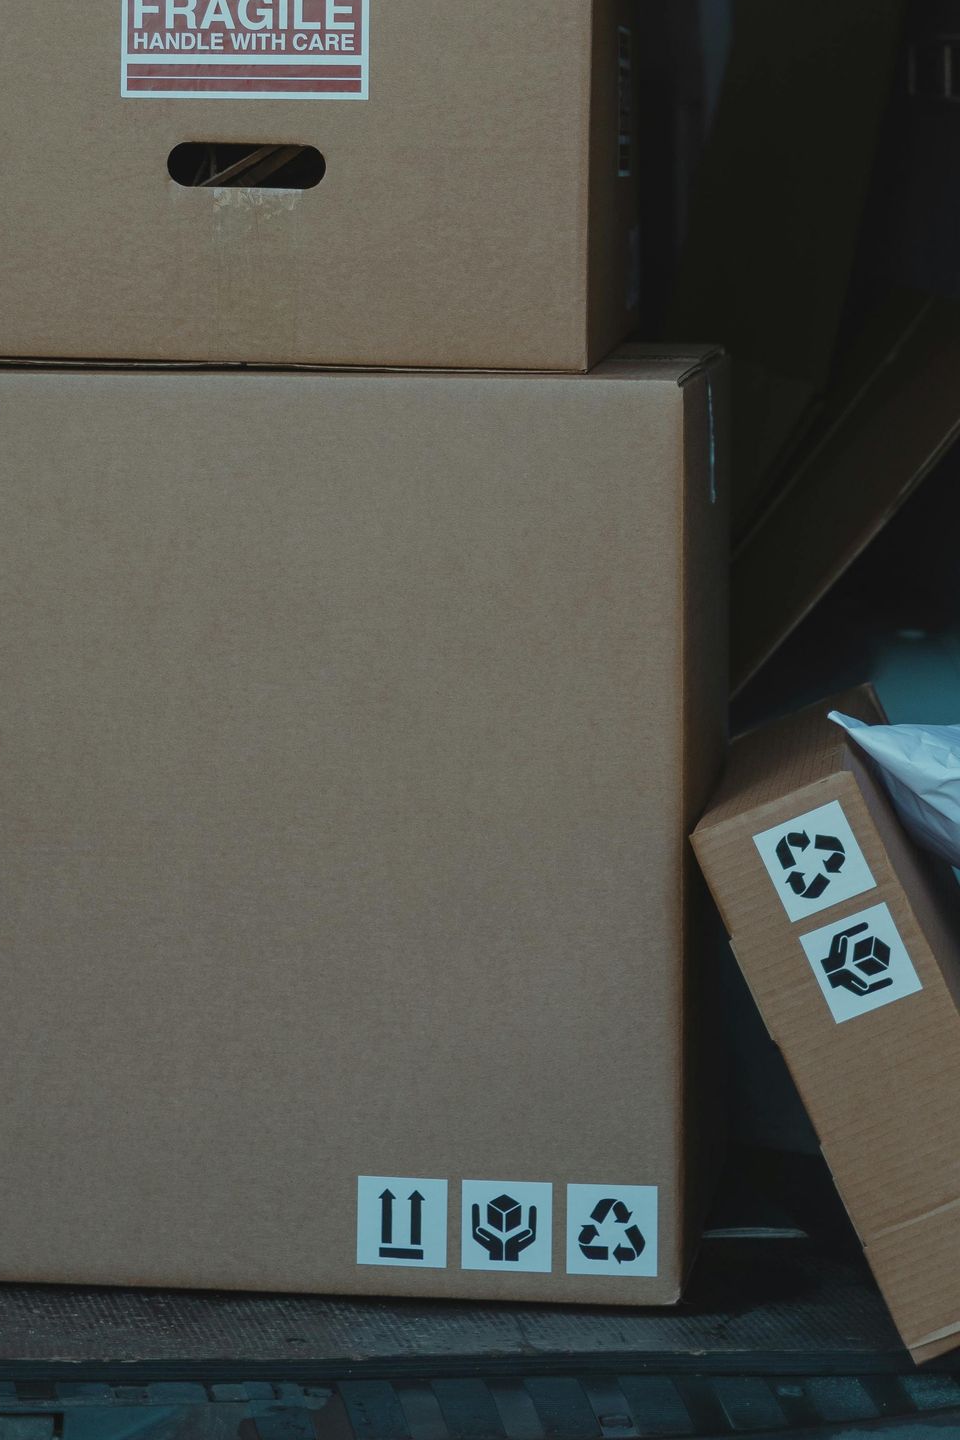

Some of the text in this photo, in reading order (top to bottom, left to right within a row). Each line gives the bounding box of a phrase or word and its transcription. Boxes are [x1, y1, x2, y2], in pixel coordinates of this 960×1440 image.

[132, 31, 355, 52] HANDLE WITH CARE
